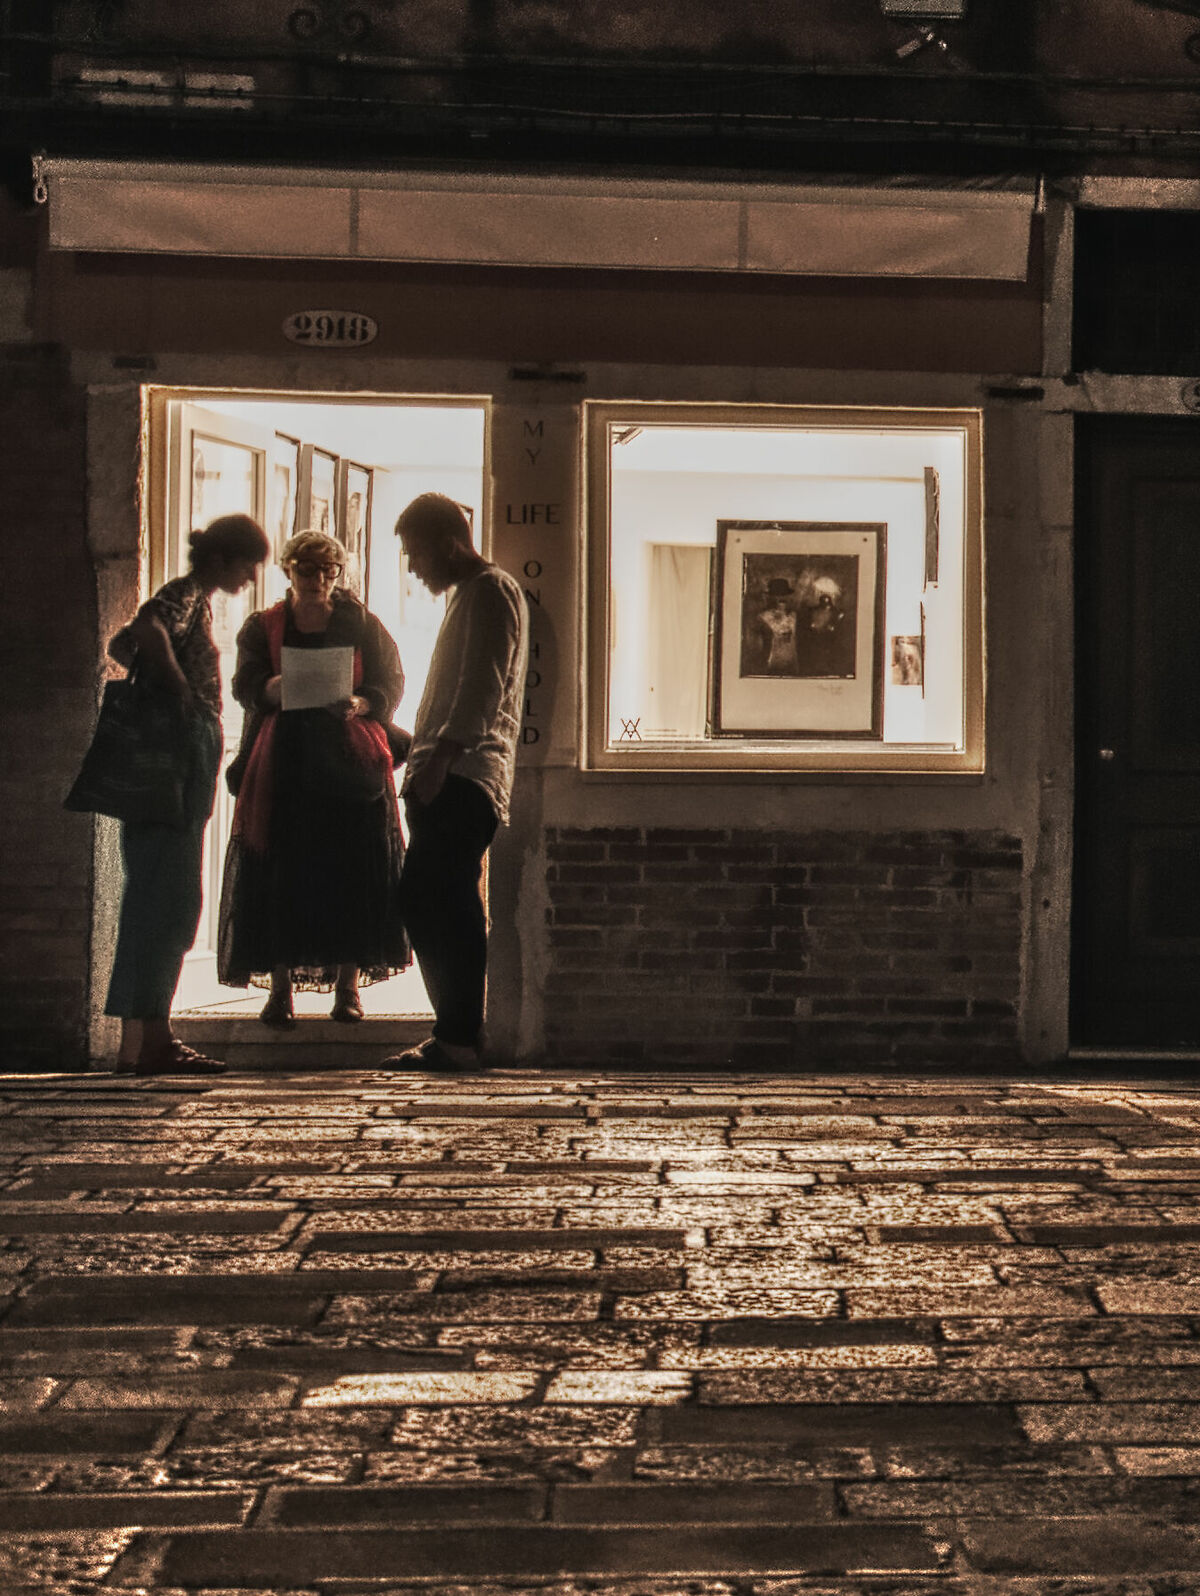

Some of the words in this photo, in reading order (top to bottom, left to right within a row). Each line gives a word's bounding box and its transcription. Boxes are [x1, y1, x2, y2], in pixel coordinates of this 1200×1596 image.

[294, 315, 369, 341] 2918
[523, 420, 544, 465] MY
[506, 503, 560, 525] LIFE
[523, 560, 542, 606] ON
